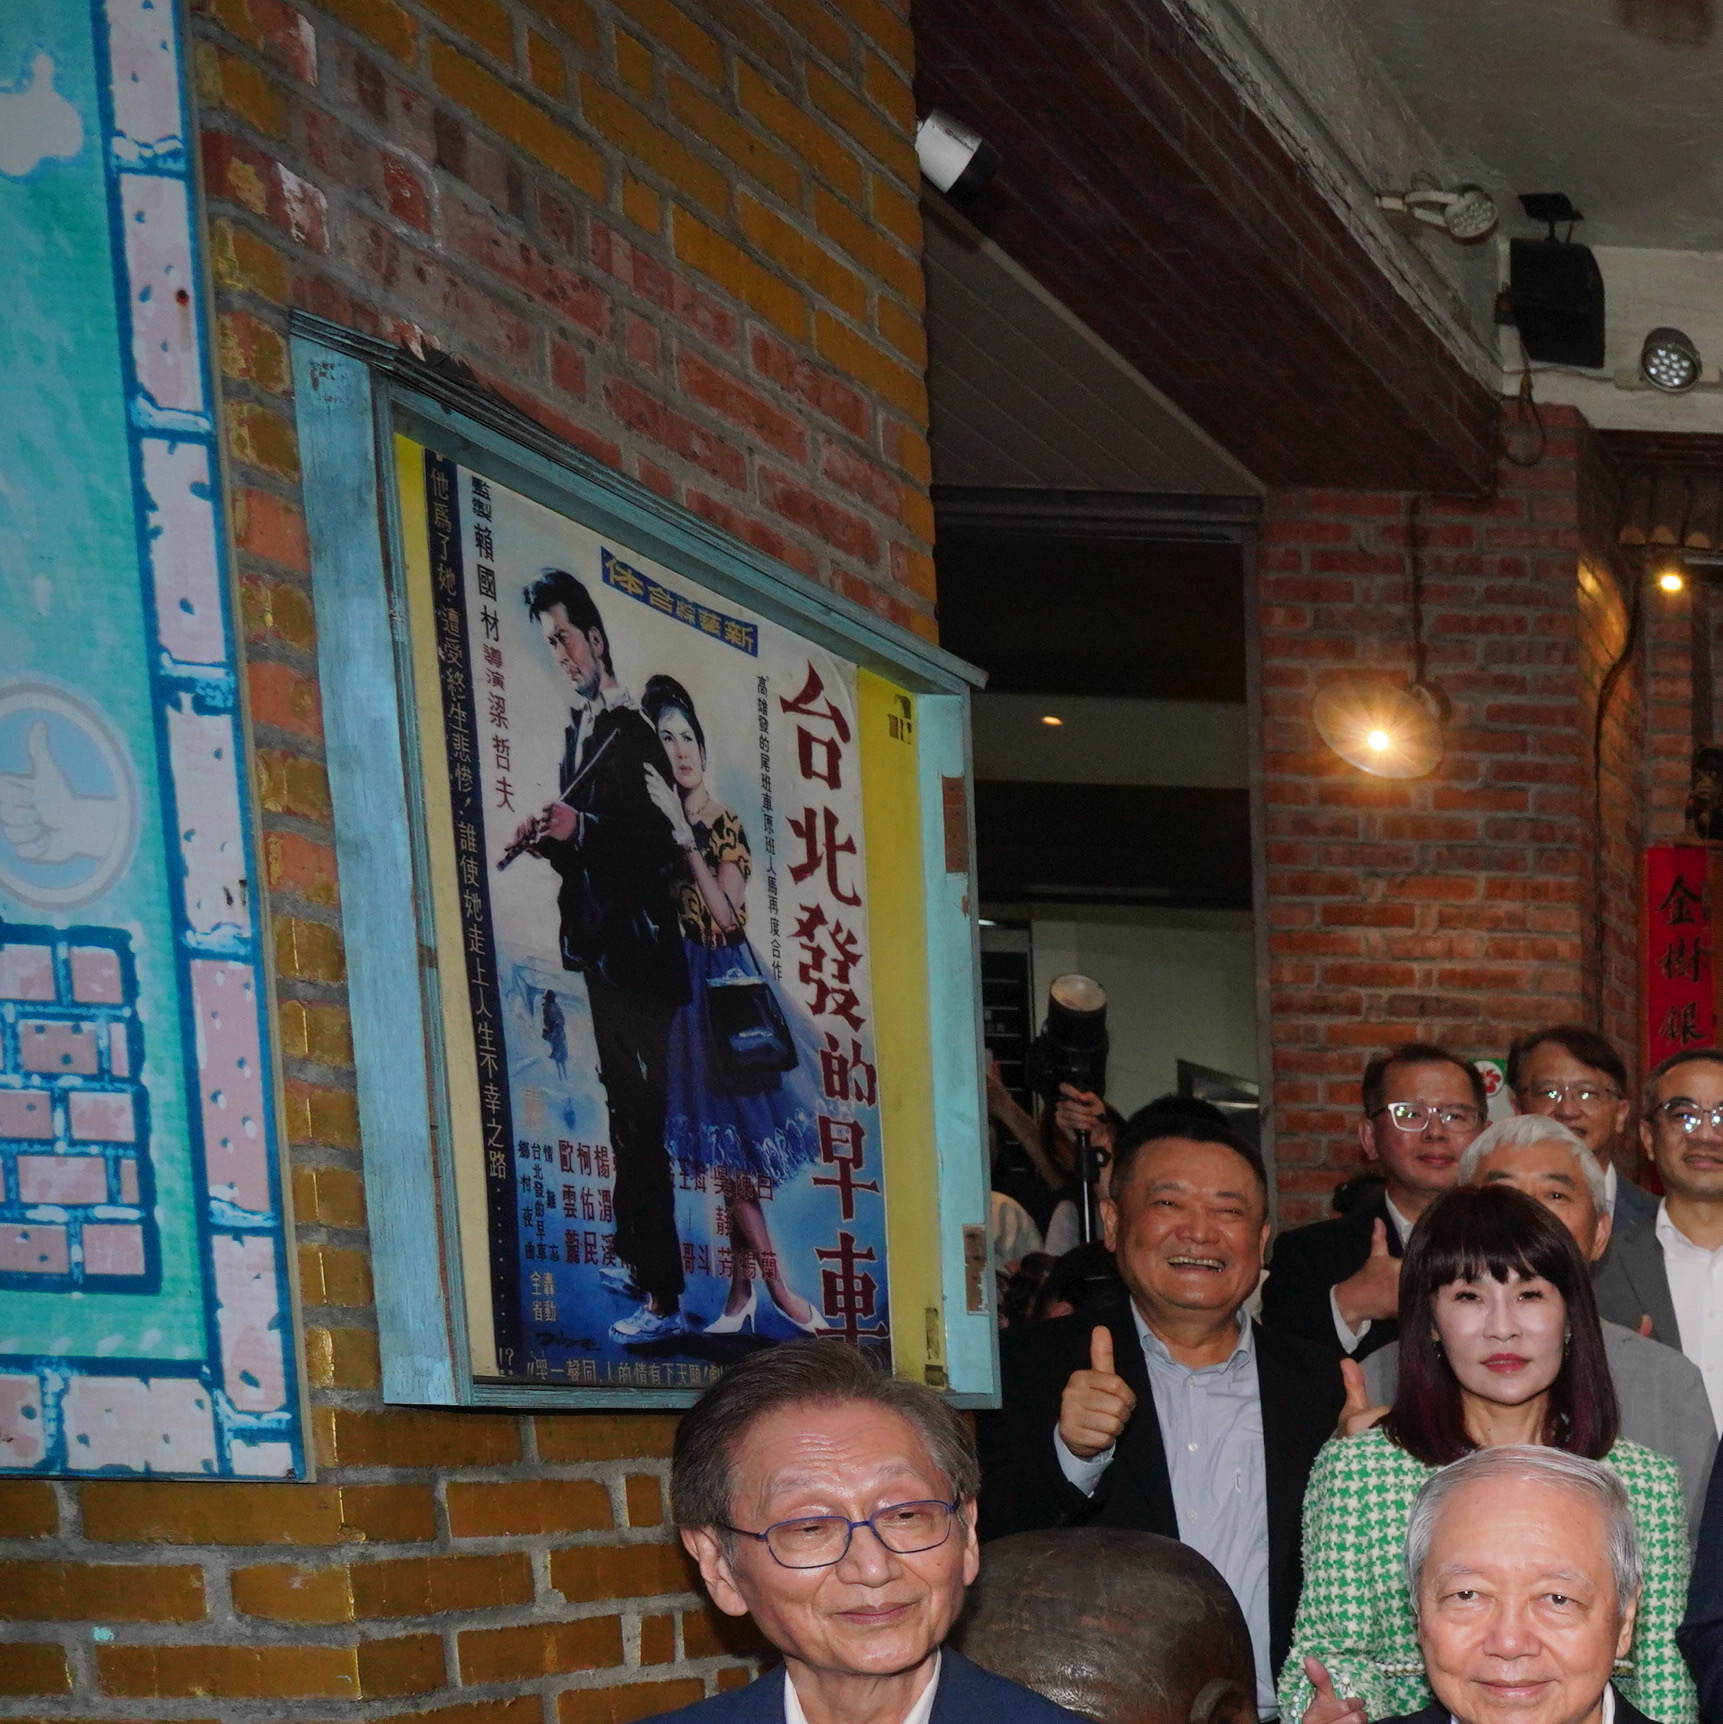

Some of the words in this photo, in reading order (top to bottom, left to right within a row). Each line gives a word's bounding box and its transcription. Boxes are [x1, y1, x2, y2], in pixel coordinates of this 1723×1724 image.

[780, 659, 887, 1343] 台北發的早車
